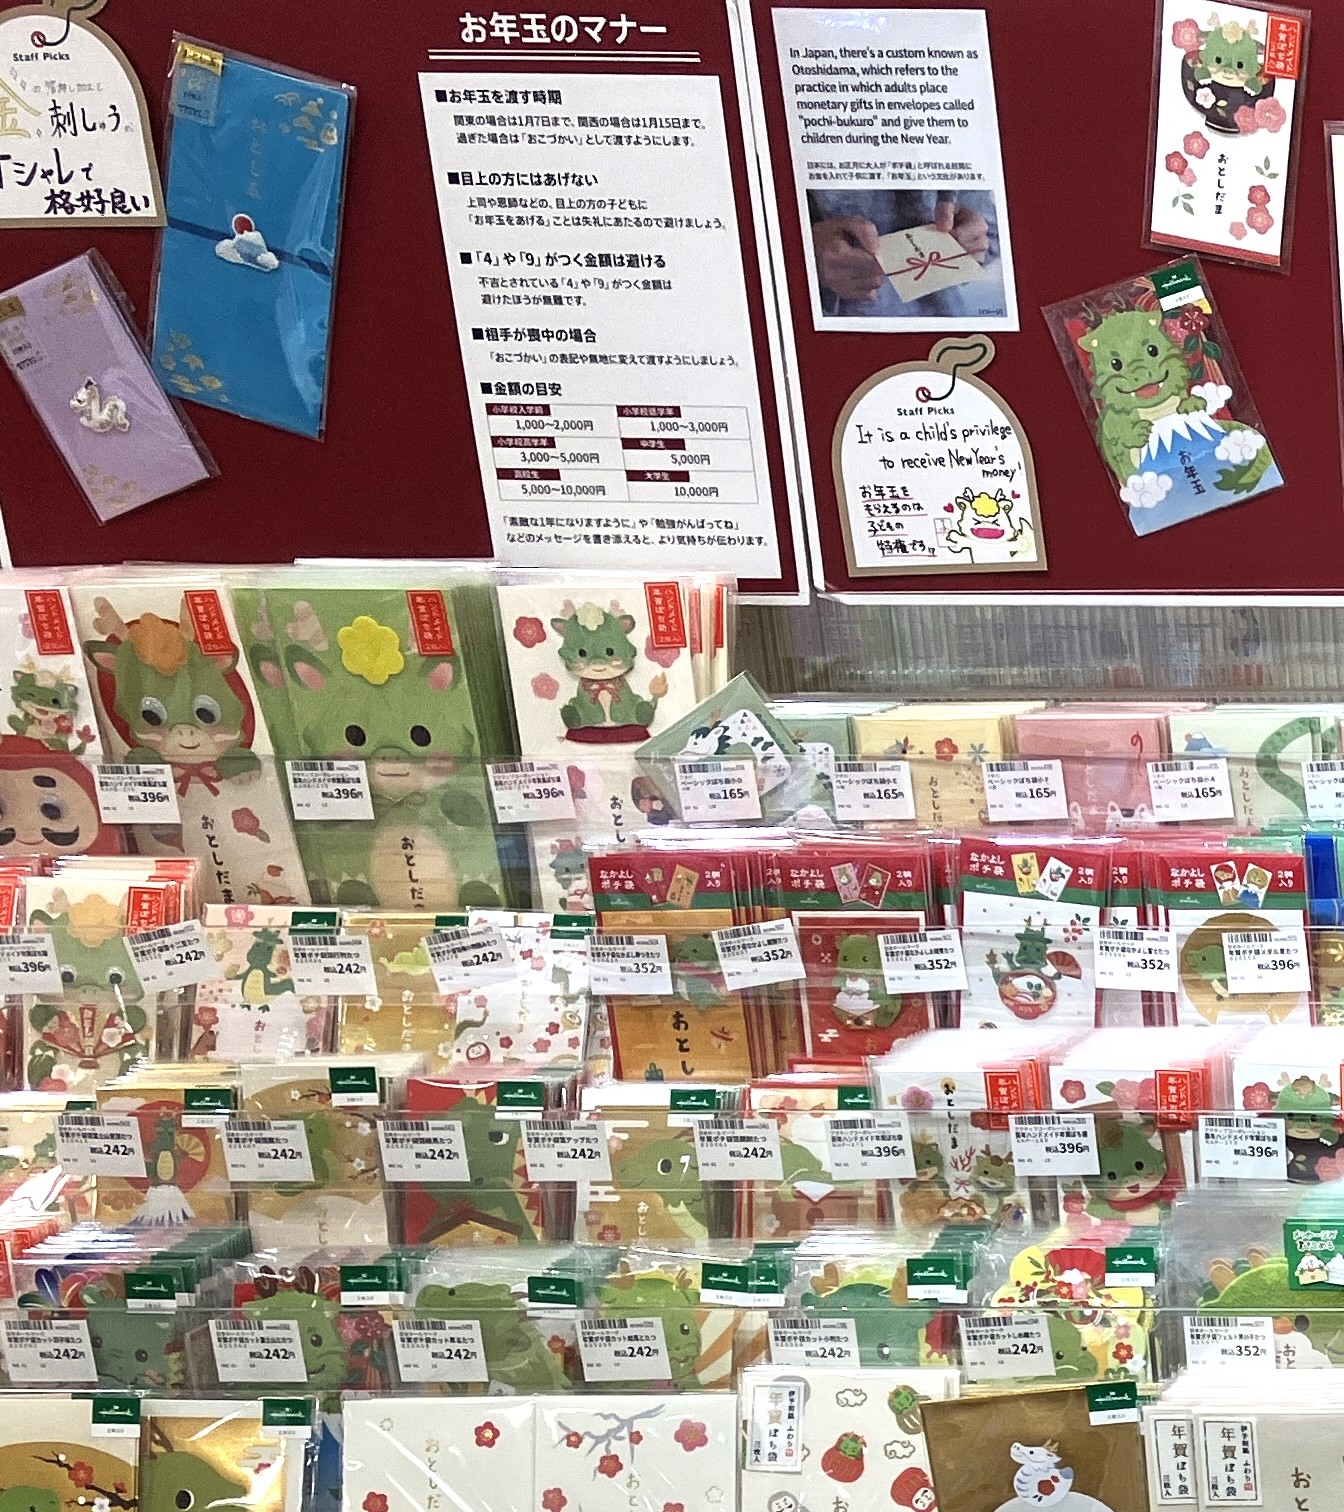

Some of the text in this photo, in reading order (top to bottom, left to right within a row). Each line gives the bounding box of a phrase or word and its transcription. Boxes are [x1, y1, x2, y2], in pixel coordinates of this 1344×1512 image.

[459, 12, 666, 43] お年玉のマナー
[13, 52, 70, 61] Staff Picks
[790, 47, 978, 60] In Japan, there's a custom known as
[792, 64, 958, 78] Otoshidama, which refers to the
[794, 82, 948, 95] practice in which adults place
[449, 90, 562, 105] お年玉を渡す時期
[797, 99, 974, 112] monetary gifts in envelopes called
[799, 115, 968, 129] "pochi-bukuro" and give them to
[801, 133, 951, 146] children during the New Year.
[461, 172, 598, 186] 目上の方にはあげない
[1215, 152, 1230, 215] おとしだま
[44, 188, 150, 216] 格好良い
[495, 383, 562, 396] 金額の目安
[897, 407, 954, 416] Staff Picks
[856, 420, 1012, 444] It is a child's privilege
[671, 454, 710, 465] 5,000円
[880, 456, 894, 469] to
[901, 453, 945, 469] receive
[1178, 448, 1206, 496] お年玉
[674, 486, 718, 497] 10,000円
[860, 484, 910, 499] お年玉を
[709, 788, 749, 799] 税込165円
[258, 1148, 302, 1160] 税込242円
[249, 1348, 295, 1359] 税込242円
[1219, 1425, 1238, 1498] 年賀ぽち袋
